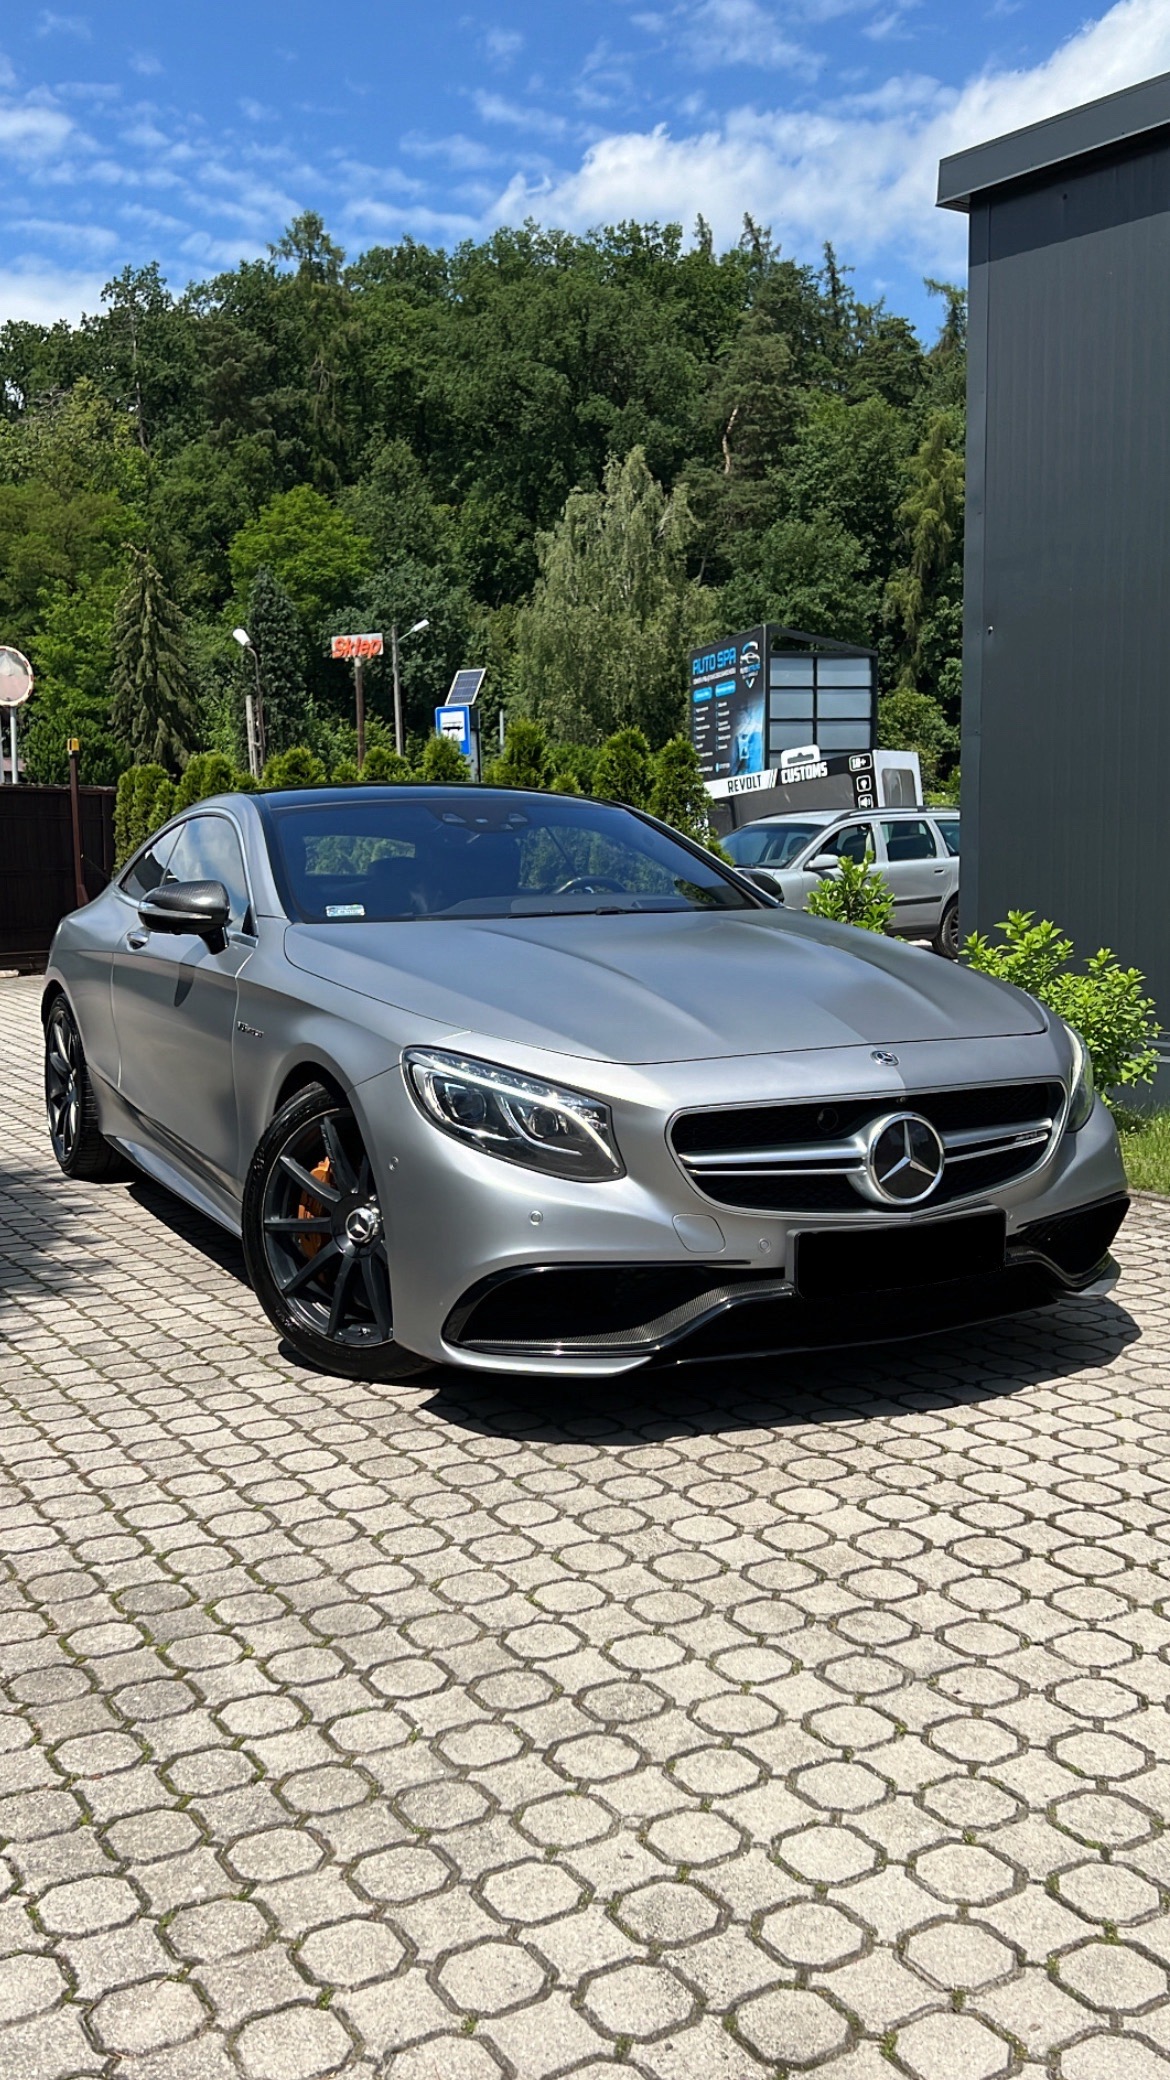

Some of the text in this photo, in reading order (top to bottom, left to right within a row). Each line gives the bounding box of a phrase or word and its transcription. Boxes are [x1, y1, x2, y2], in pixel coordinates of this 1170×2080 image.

[332, 636, 382, 659] Sklep
[692, 653, 716, 675] AUTO
[717, 647, 736, 668] SPA
[852, 757, 867, 769] 18+
[727, 761, 828, 793] REVOLT CUSTOMS
